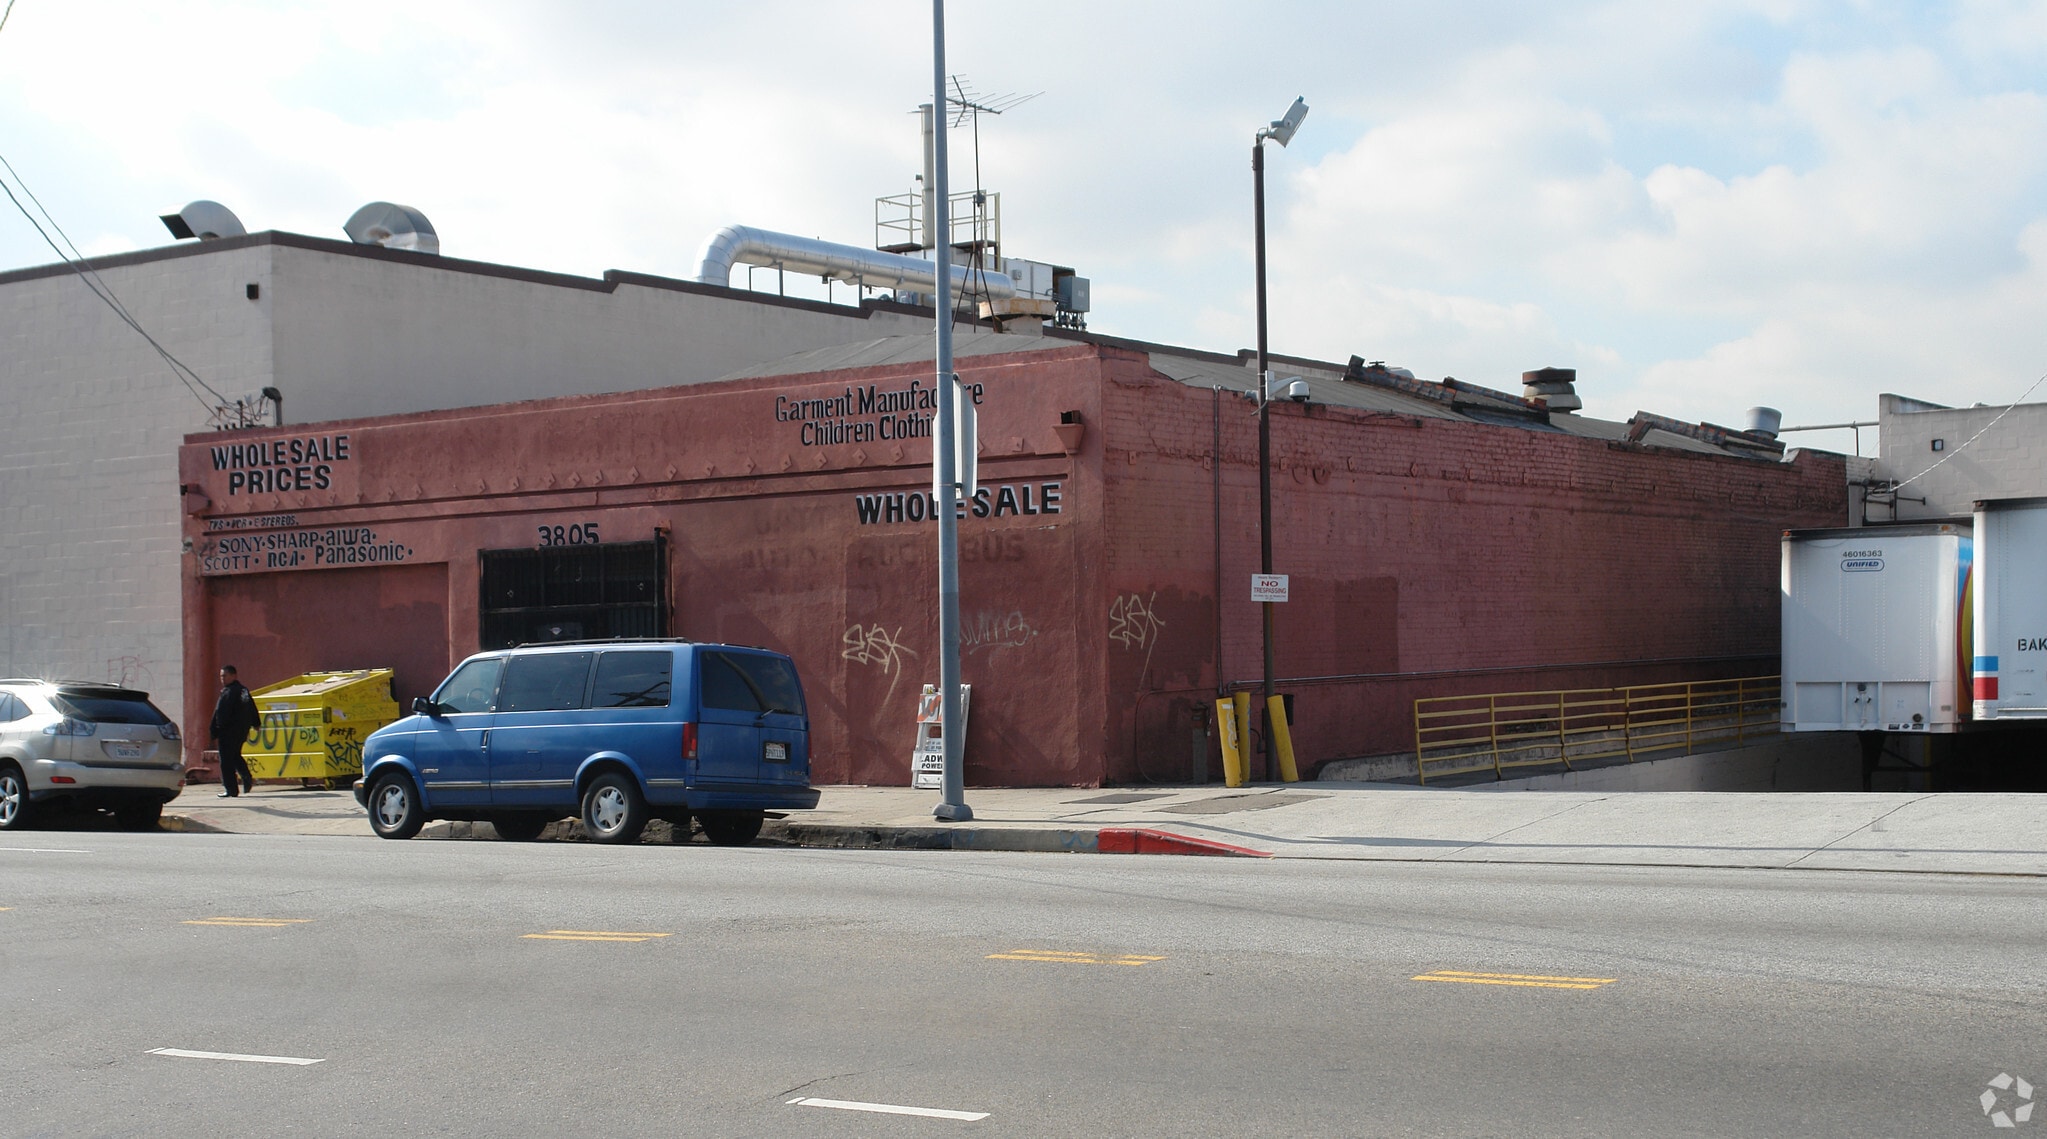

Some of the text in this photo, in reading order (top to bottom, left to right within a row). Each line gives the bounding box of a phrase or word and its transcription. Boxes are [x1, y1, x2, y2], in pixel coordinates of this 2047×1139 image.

[775, 380, 984, 423] Garment Manuface
[801, 411, 935, 447] Children Clothi
[211, 435, 350, 471] WHOLESALE
[229, 465, 332, 496] PRICES
[538, 522, 600, 546] 3805
[204, 555, 251, 571] SCOTT
[315, 540, 405, 565] Panasonic
